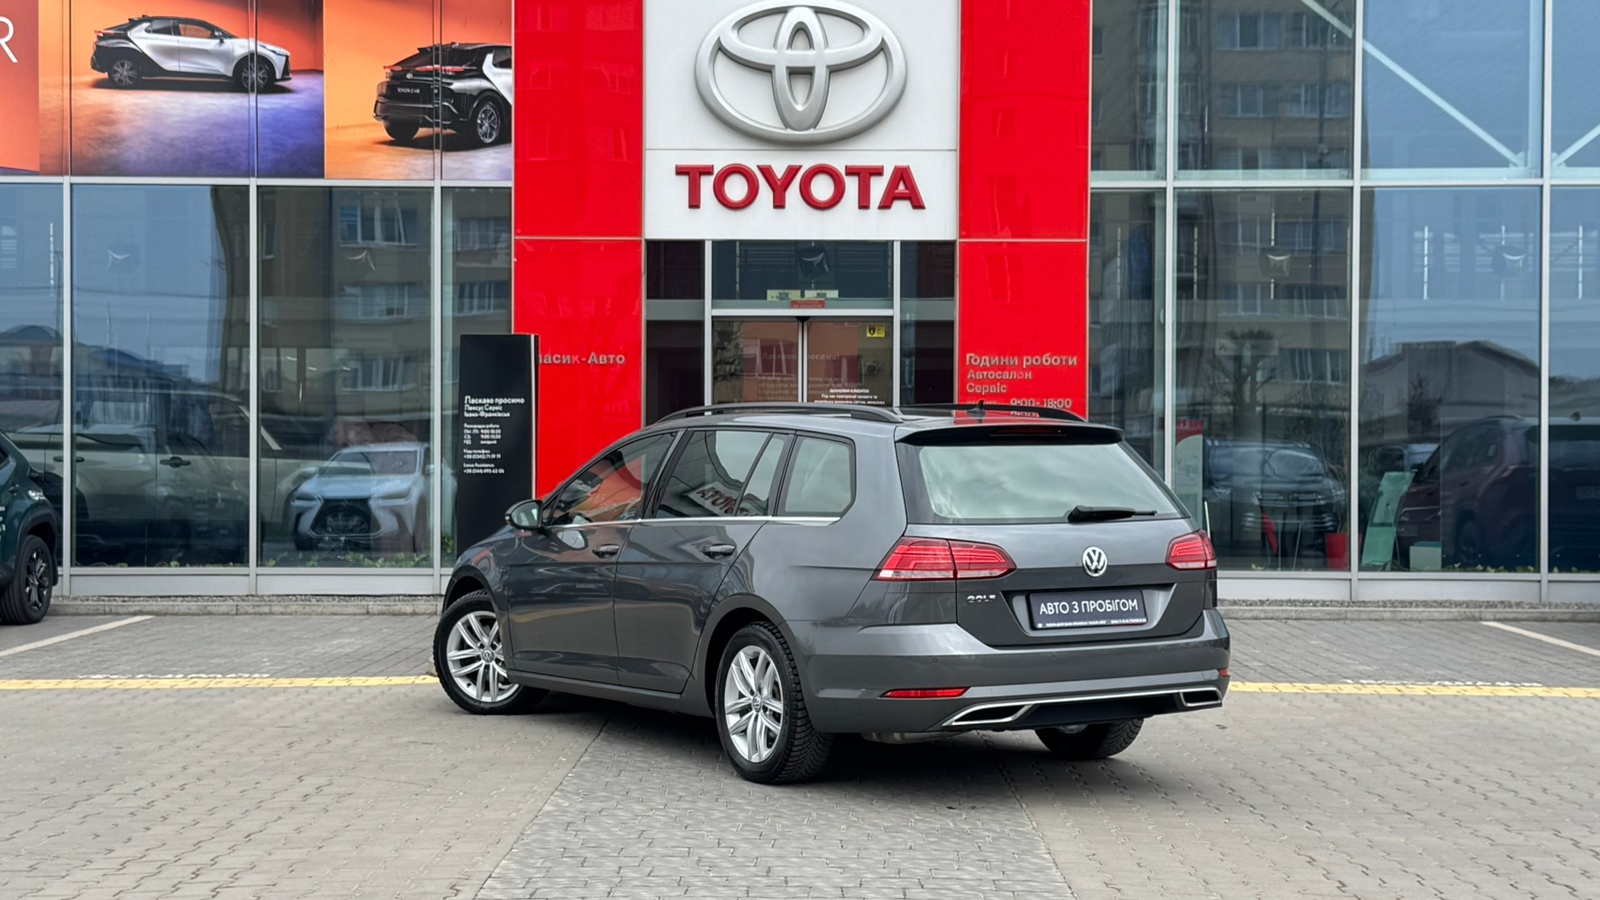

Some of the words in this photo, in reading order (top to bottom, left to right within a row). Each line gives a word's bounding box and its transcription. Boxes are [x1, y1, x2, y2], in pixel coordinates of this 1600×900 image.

[675, 163, 926, 210] TOYOTA
[966, 353, 1018, 367] Години
[1023, 353, 1077, 368] роботи
[967, 370, 1032, 380] Автосалон
[966, 382, 1007, 395] Сервіс
[464, 395, 494, 404] Ласкаво
[495, 397, 525, 405] просимо
[1039, 601, 1070, 615] АВТО
[1081, 599, 1139, 613] ПРОБІГОМ
